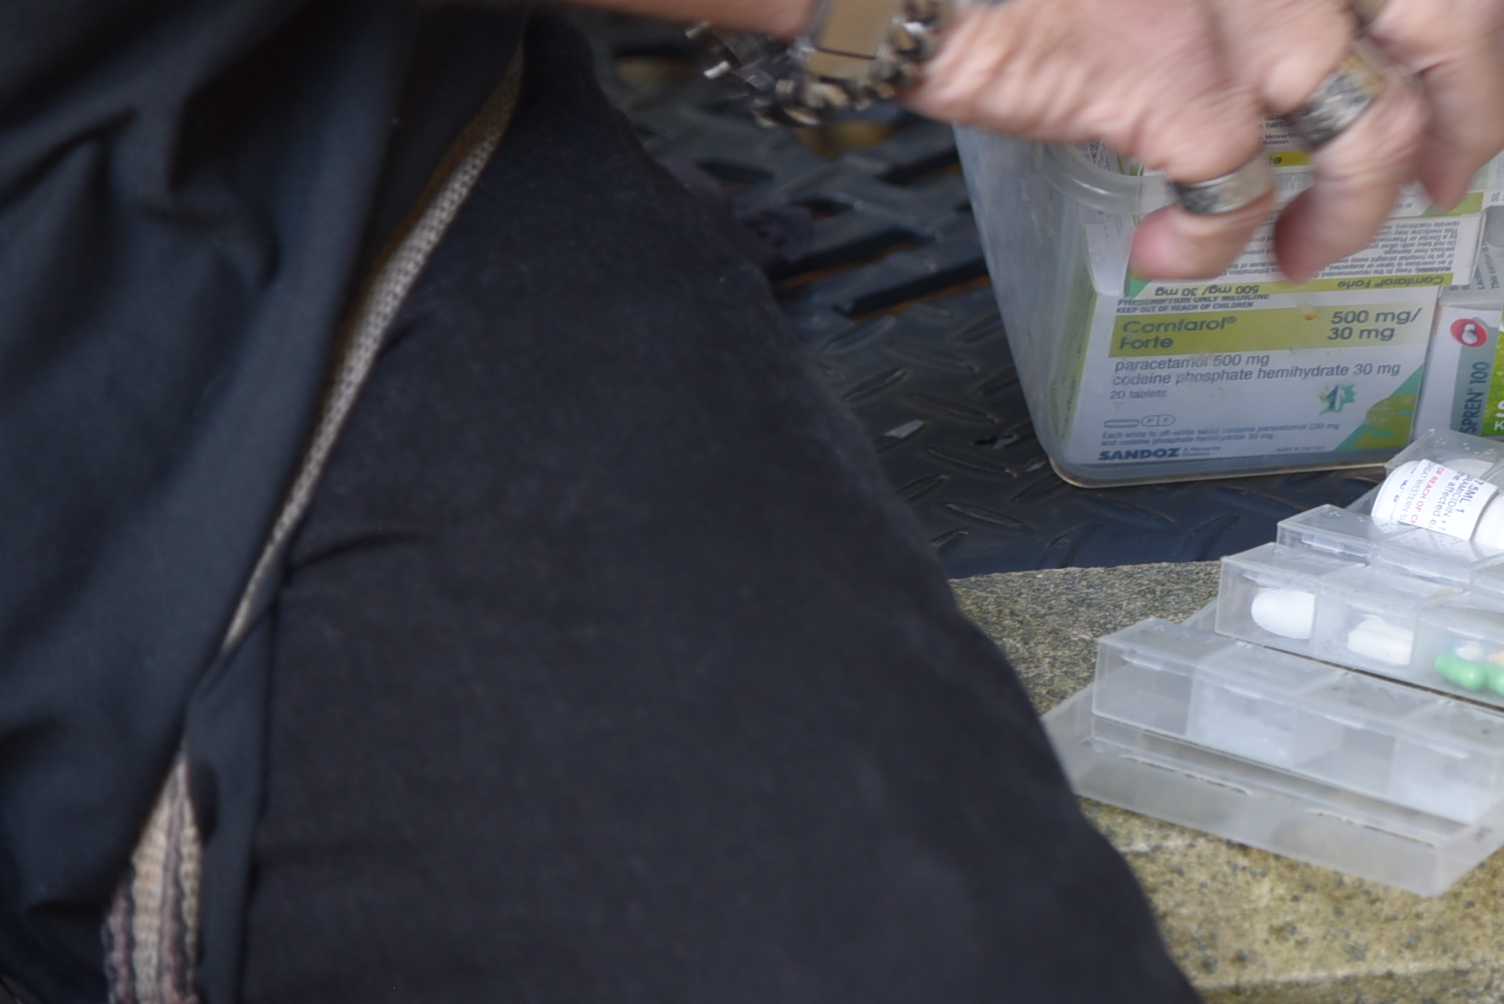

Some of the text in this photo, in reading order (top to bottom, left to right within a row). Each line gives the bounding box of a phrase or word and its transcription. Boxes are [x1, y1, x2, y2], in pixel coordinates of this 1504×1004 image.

[1154, 285, 1259, 299] 500 mg/ 30 mg
[1337, 279, 1371, 291] Forte
[1330, 307, 1422, 328] 500 mg/
[1120, 325, 1395, 350] Forte 30 mg
[1112, 361, 1401, 386] codeine phosphate hemihydrate 30 mg
[1114, 353, 1270, 373] paracetamol 500 mg
[1469, 361, 1489, 384] 100
[1109, 388, 1166, 400] 20 tablets
[1098, 448, 1181, 460] SANDOZ
[1403, 477, 1424, 513] WESTERN
[1420, 474, 1439, 502] REACH
[1432, 481, 1457, 517] affected
[1458, 479, 1484, 505] 7.5ML
[1413, 501, 1424, 514] OF
